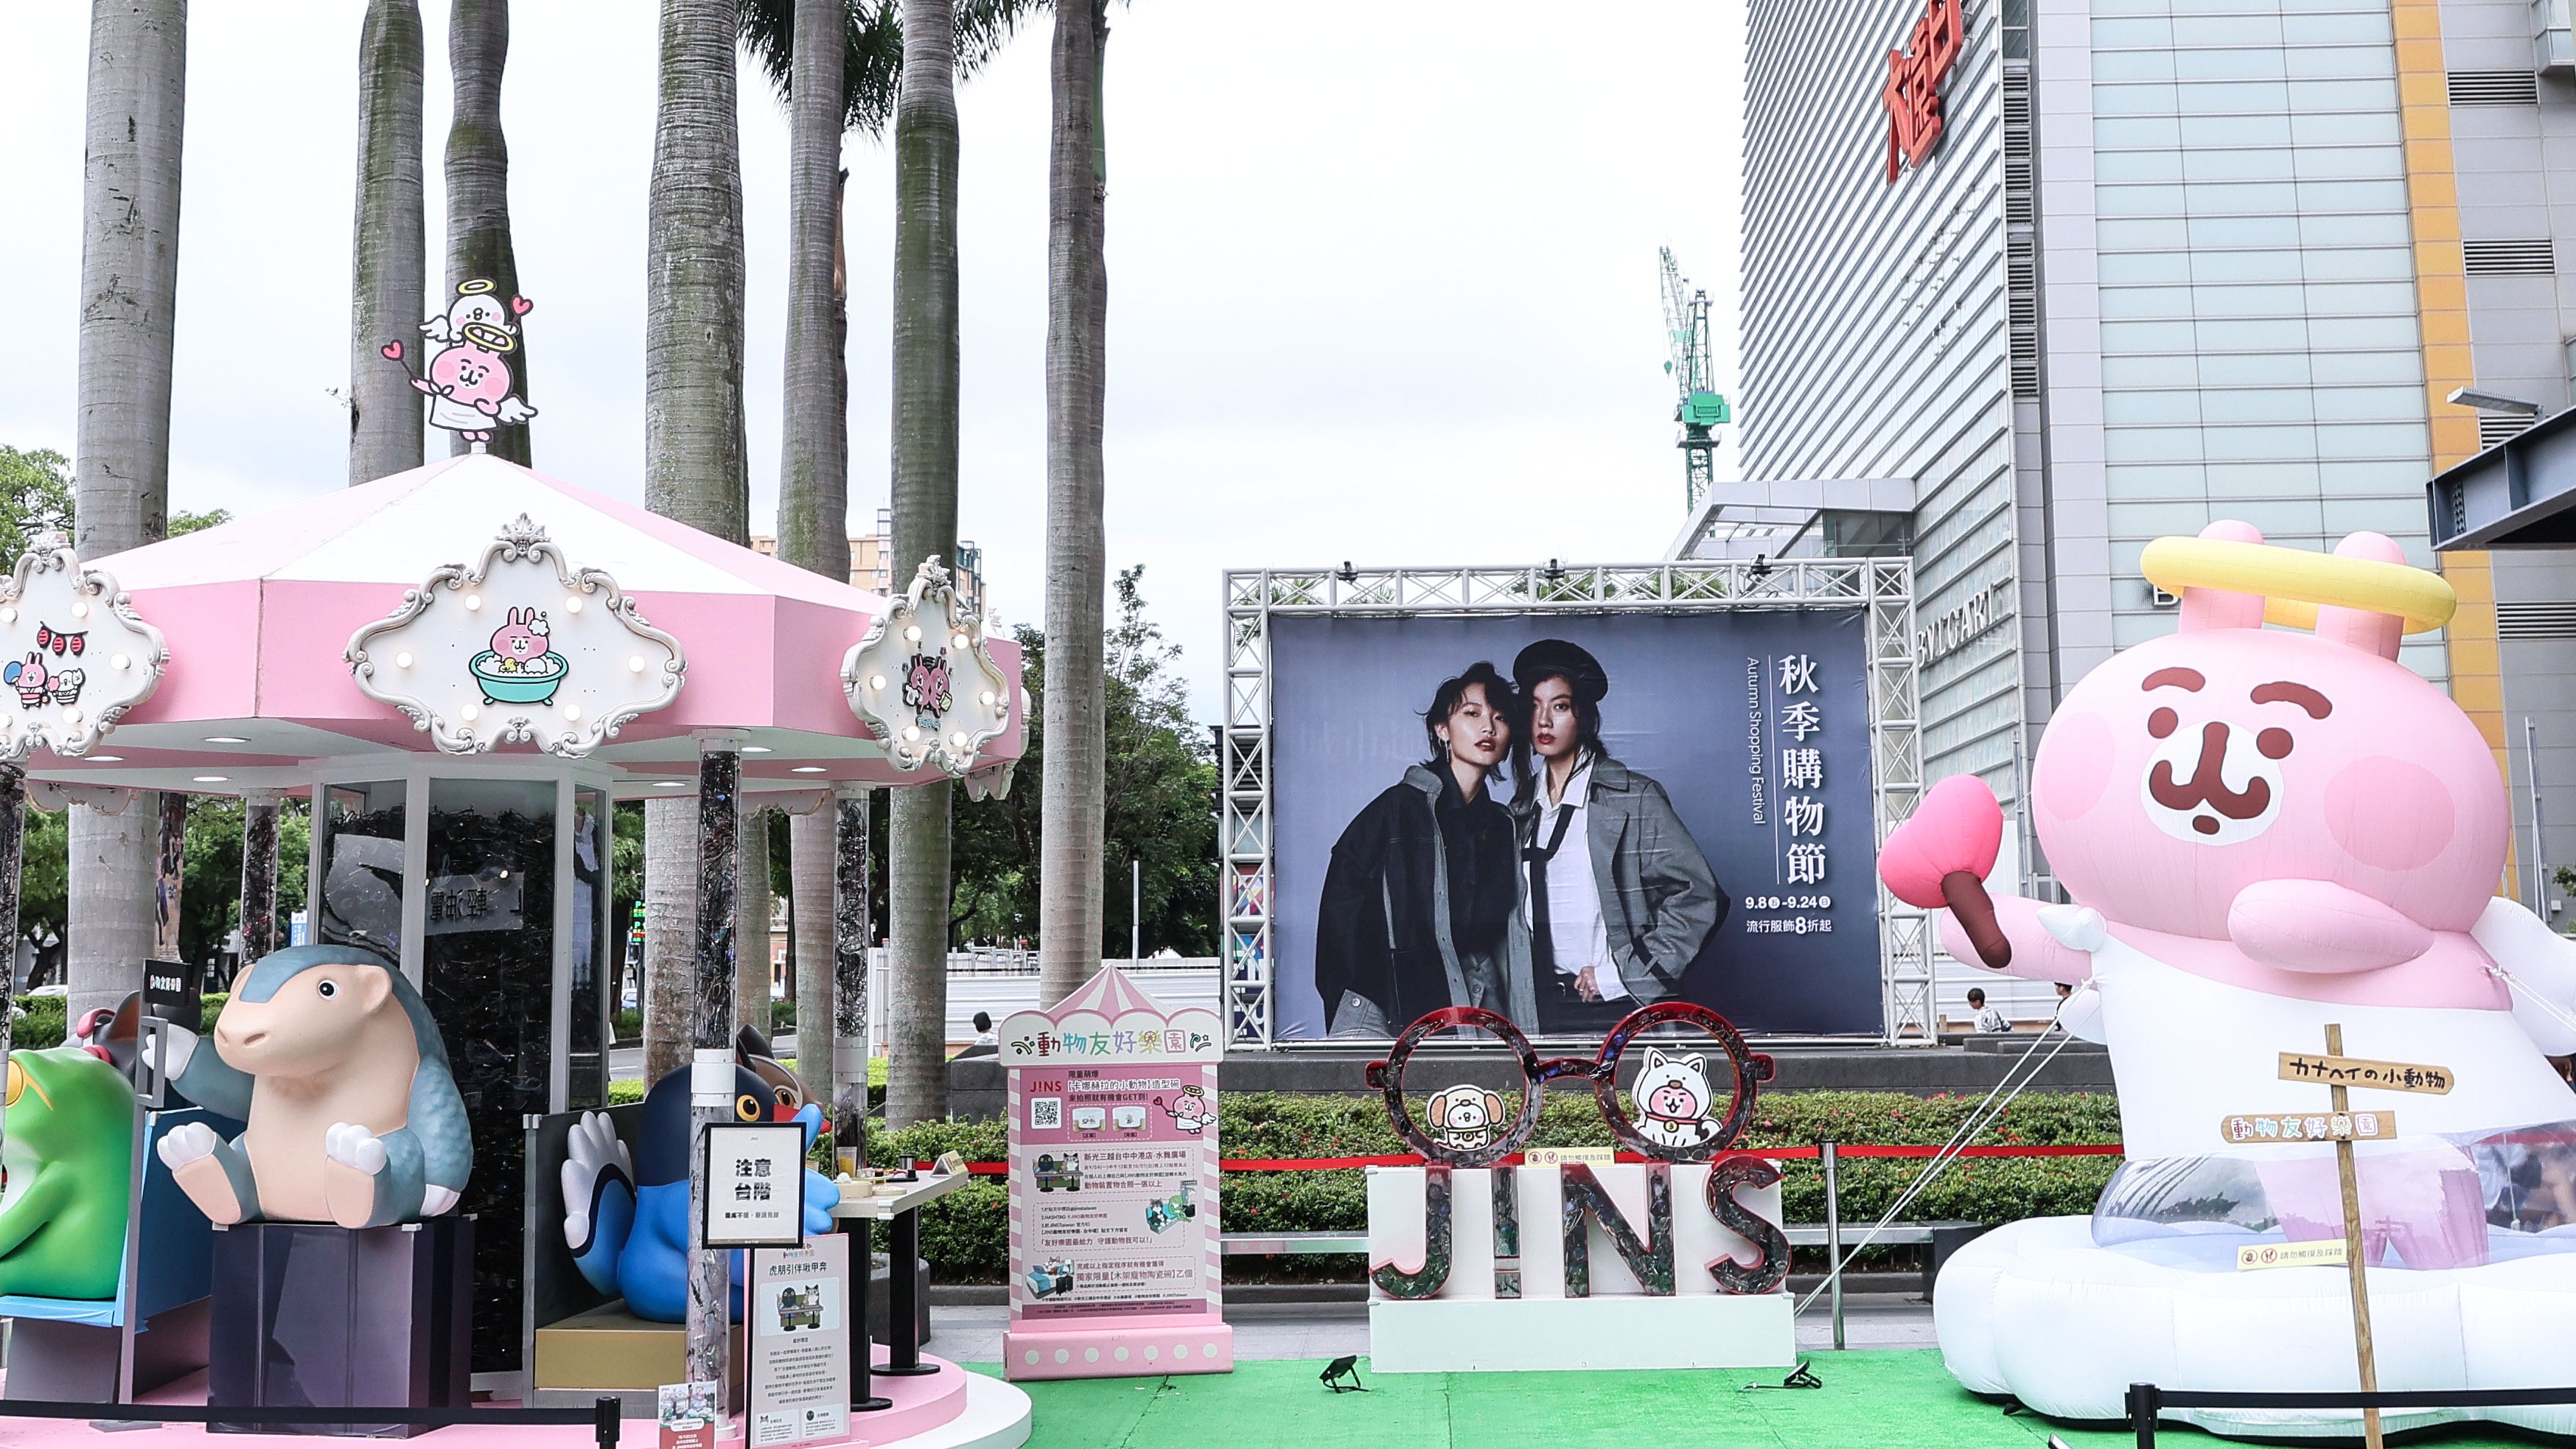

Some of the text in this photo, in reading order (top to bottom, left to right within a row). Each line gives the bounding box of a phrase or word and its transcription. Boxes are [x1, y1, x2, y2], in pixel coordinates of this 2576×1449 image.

[1747, 657, 1766, 824] Autumn Shopping Festival
[1778, 654, 1826, 884] 秋季購物節
[1746, 916, 1832, 934] 流行服飾8折起
[1037, 1030, 1187, 1057] 動物友好樂園
[2289, 1057, 2446, 1089] カナヘイの小動物
[2231, 1114, 2379, 1140] 動物友好樂園
[736, 1159, 772, 1177] 注意
[735, 1182, 772, 1201] 台階
